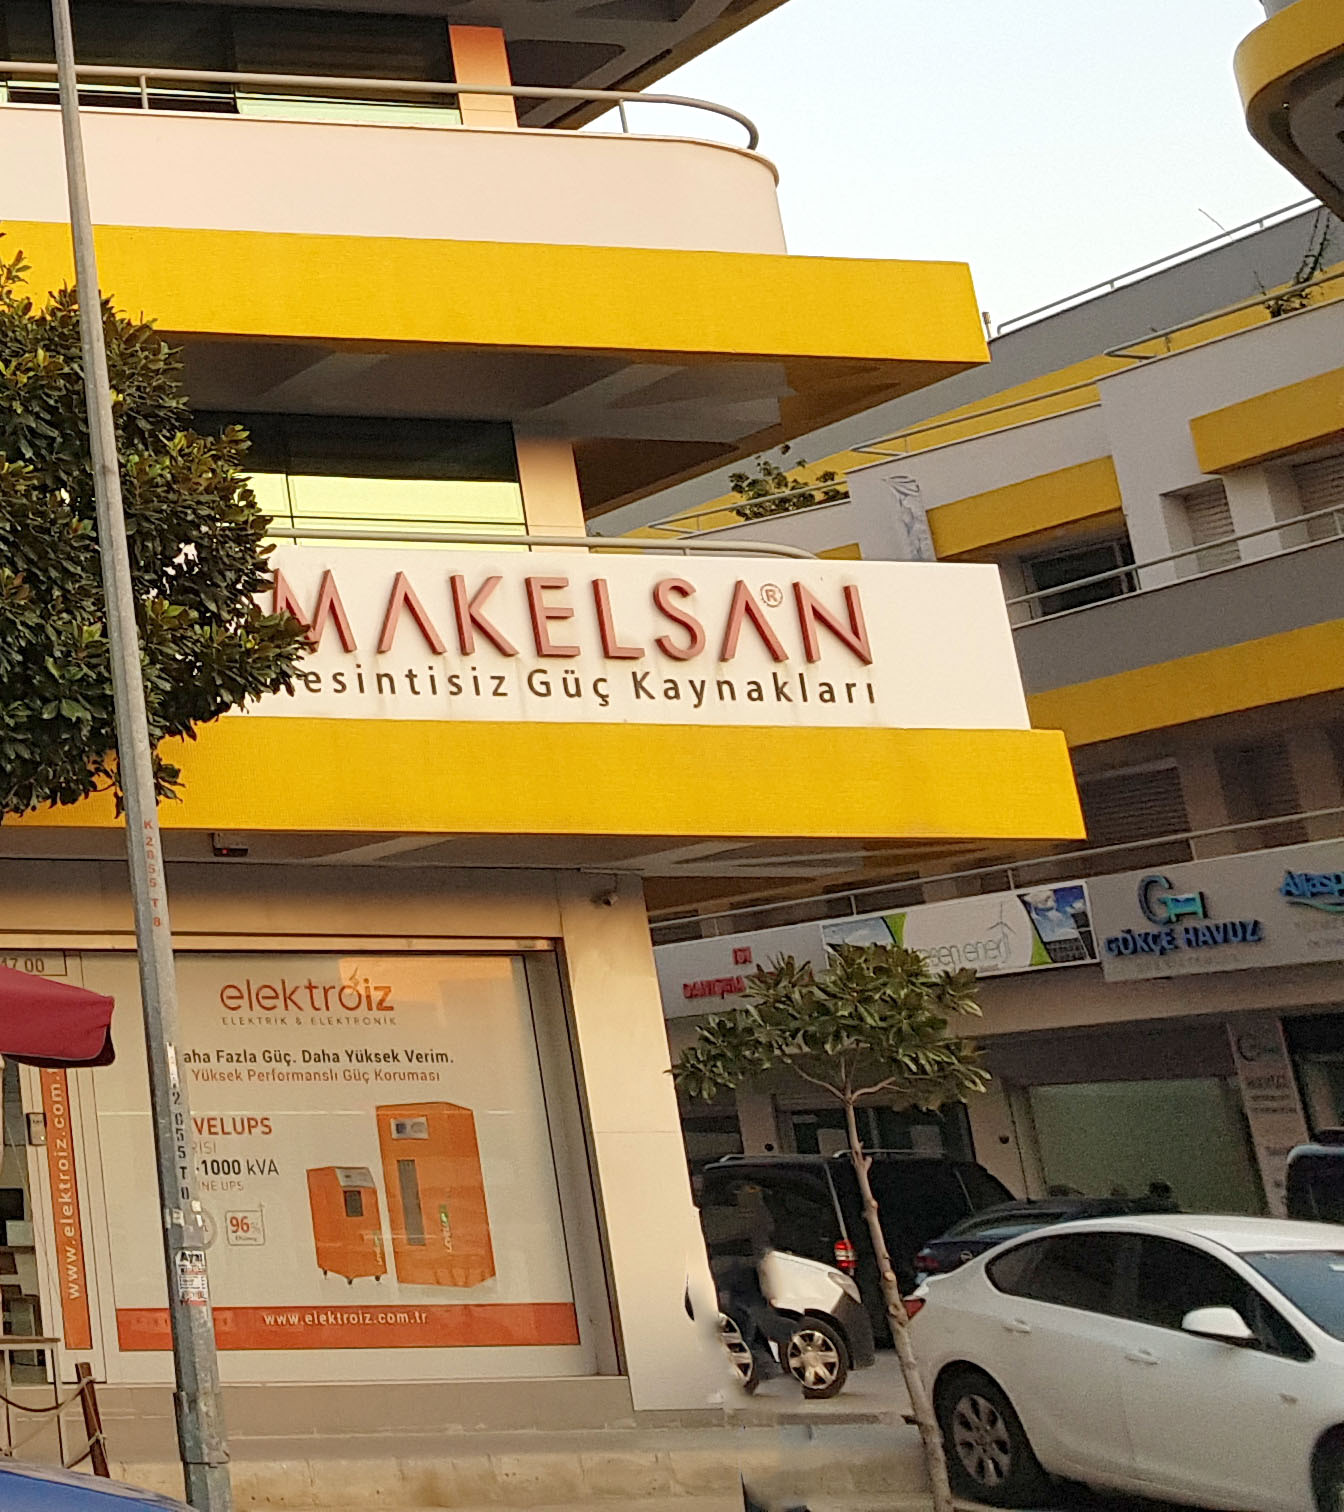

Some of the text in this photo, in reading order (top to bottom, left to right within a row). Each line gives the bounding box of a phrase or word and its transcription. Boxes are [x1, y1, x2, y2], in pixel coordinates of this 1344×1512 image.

[272, 567, 873, 665] MAKELSAN
[296, 663, 877, 710] esintisiz Güç Kaynakları
[1183, 919, 1266, 949] HAVUZ
[220, 978, 395, 1011] elektroiz
[182, 1048, 454, 1067] aha Fazla Güç. Daha Yüksek Verim.
[192, 1068, 441, 1084] Yüksek Performanslı Güç Koruması
[192, 1117, 273, 1136] VELUPS
[246, 1158, 280, 1176] kVA
[49, 1069, 81, 1300] www.elektroiz.com.
[220, 1180, 245, 1192] UPS
[263, 1310, 427, 1326] www.elektroiz.com.tr
